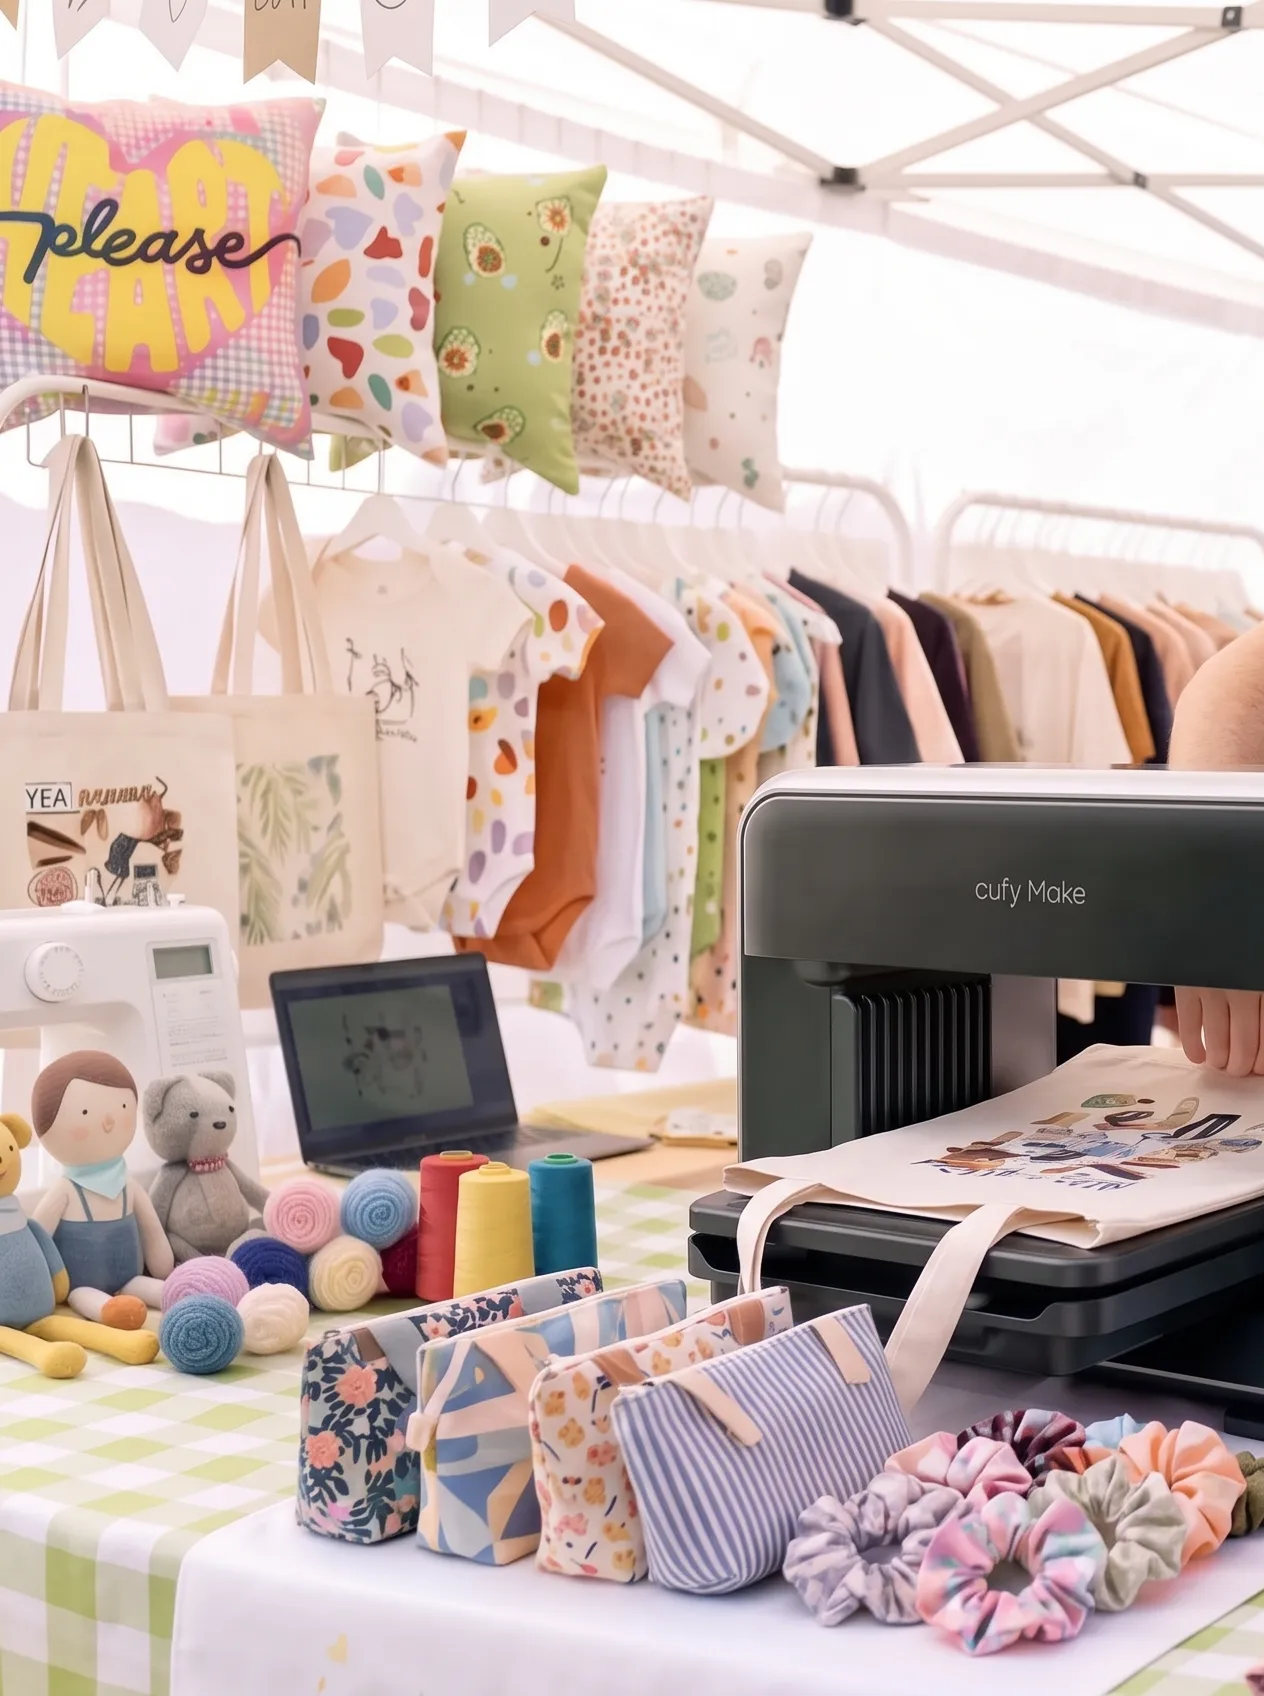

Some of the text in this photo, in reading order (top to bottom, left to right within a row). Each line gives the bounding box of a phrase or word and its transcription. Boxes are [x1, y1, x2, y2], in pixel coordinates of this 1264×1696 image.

[0, 198, 302, 284] please
[25, 788, 68, 809] YEA
[975, 877, 1086, 908] cufy Make
